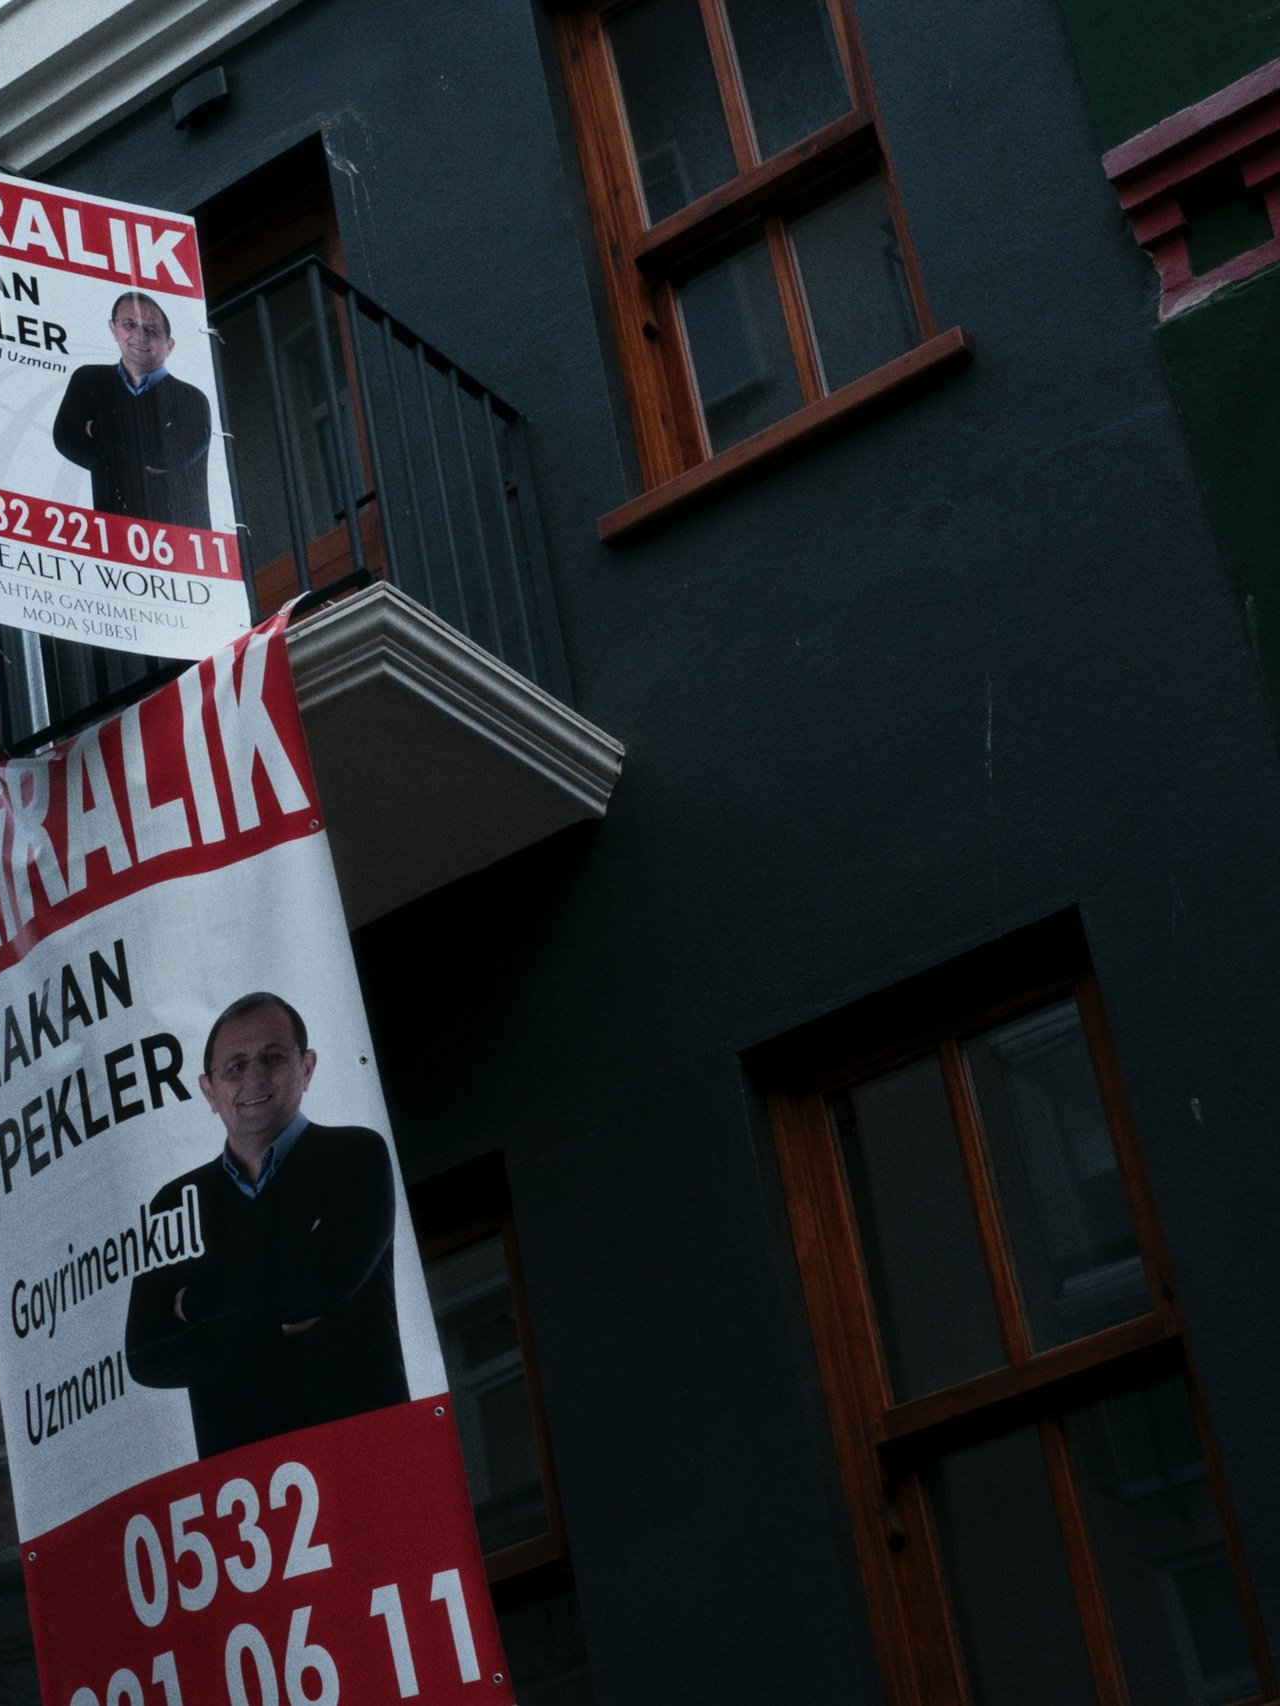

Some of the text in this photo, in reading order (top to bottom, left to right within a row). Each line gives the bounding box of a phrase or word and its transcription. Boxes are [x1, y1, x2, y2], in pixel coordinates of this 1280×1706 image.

[7, 350, 68, 374] Uzmanı
[44, 507, 110, 554] 221
[127, 523, 174, 565] 06
[189, 534, 229, 573] 11
[59, 594, 190, 630] GAYRİMENKUL
[95, 564, 211, 606] WORLD
[22, 606, 139, 642] MODA ŞUBESİ
[11, 1187, 204, 1340] Gayrimenkul
[25, 1350, 126, 1446] Uzmanı
[124, 1461, 333, 1628] 0532
[224, 1605, 340, 1706] 06
[369, 1568, 482, 1699] 11
